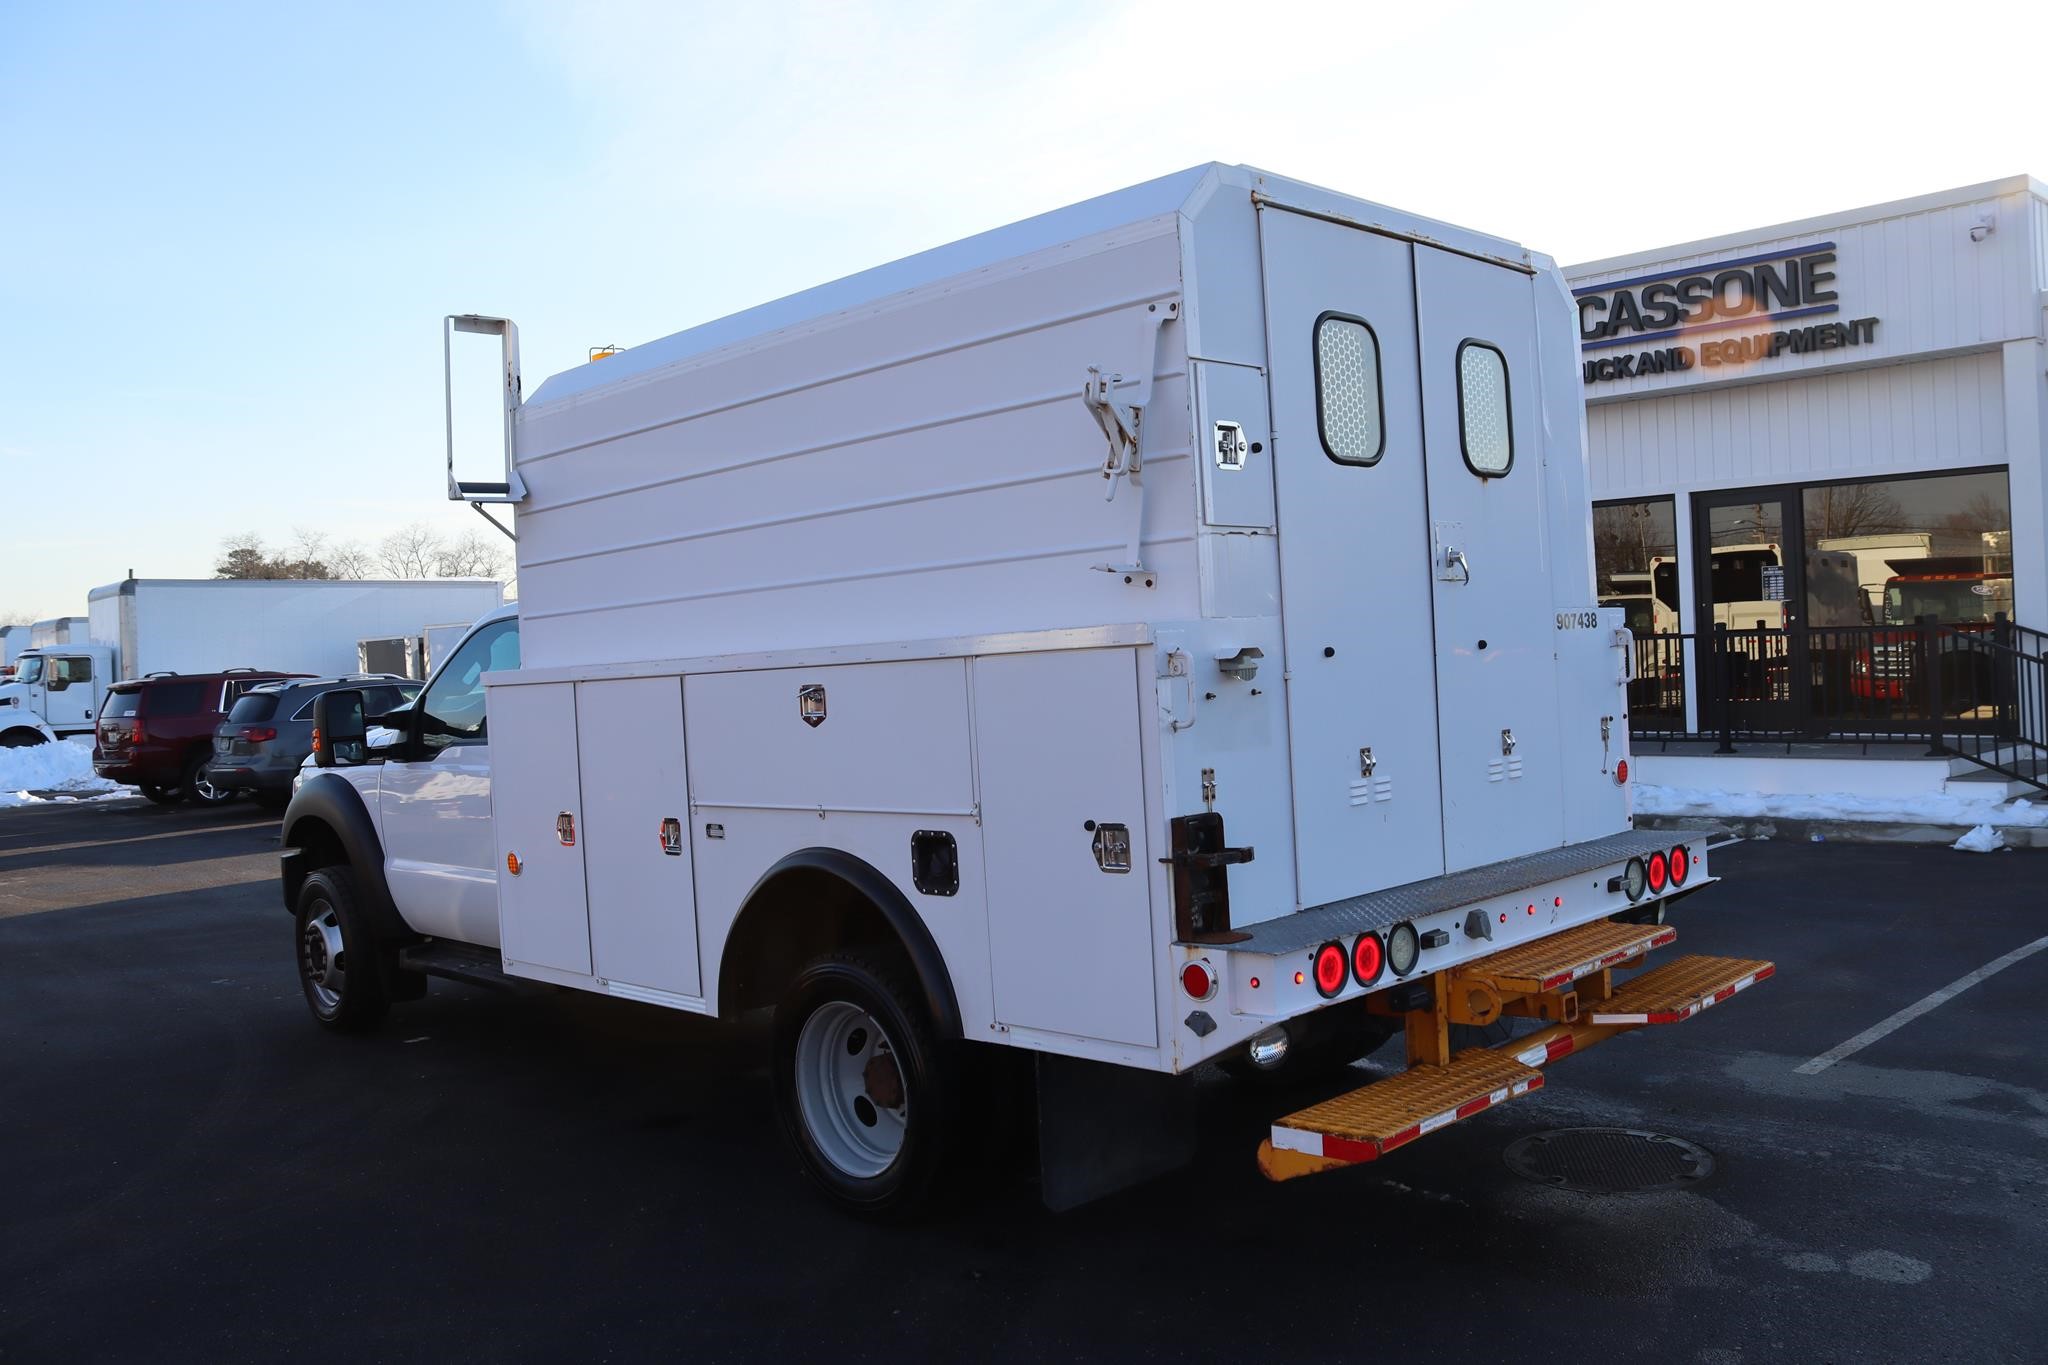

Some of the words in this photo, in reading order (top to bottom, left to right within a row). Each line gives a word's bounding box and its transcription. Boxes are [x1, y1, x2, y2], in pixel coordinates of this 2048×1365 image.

[1577, 253, 1838, 340] CASSONE
[1701, 317, 1880, 367] EQUIPMENT
[1556, 612, 1597, 631] 907438
